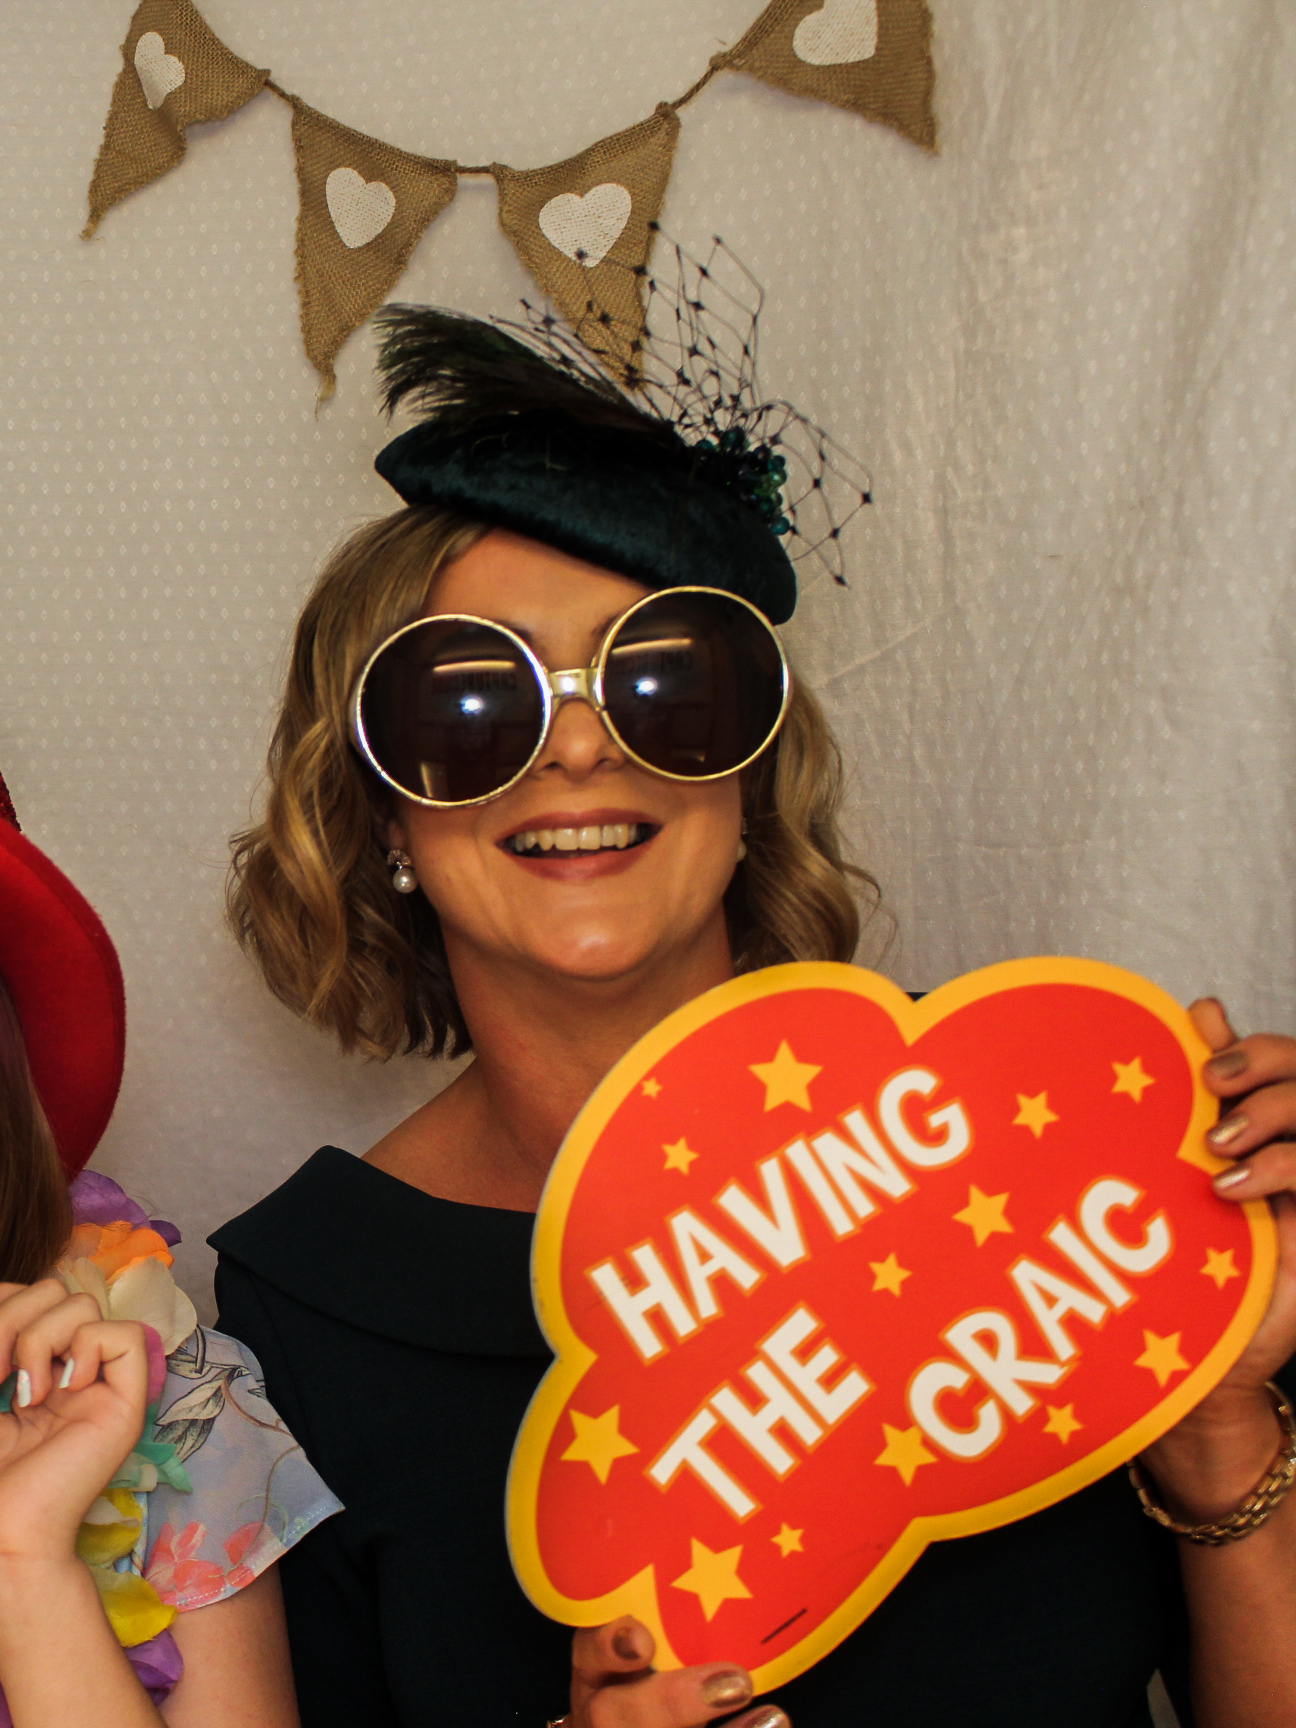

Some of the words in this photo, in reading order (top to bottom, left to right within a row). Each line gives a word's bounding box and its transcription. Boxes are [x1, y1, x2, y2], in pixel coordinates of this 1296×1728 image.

[590, 1069, 971, 1359] HAVING
[649, 1307, 871, 1518] THE
[909, 1179, 1171, 1458] CRAIC
